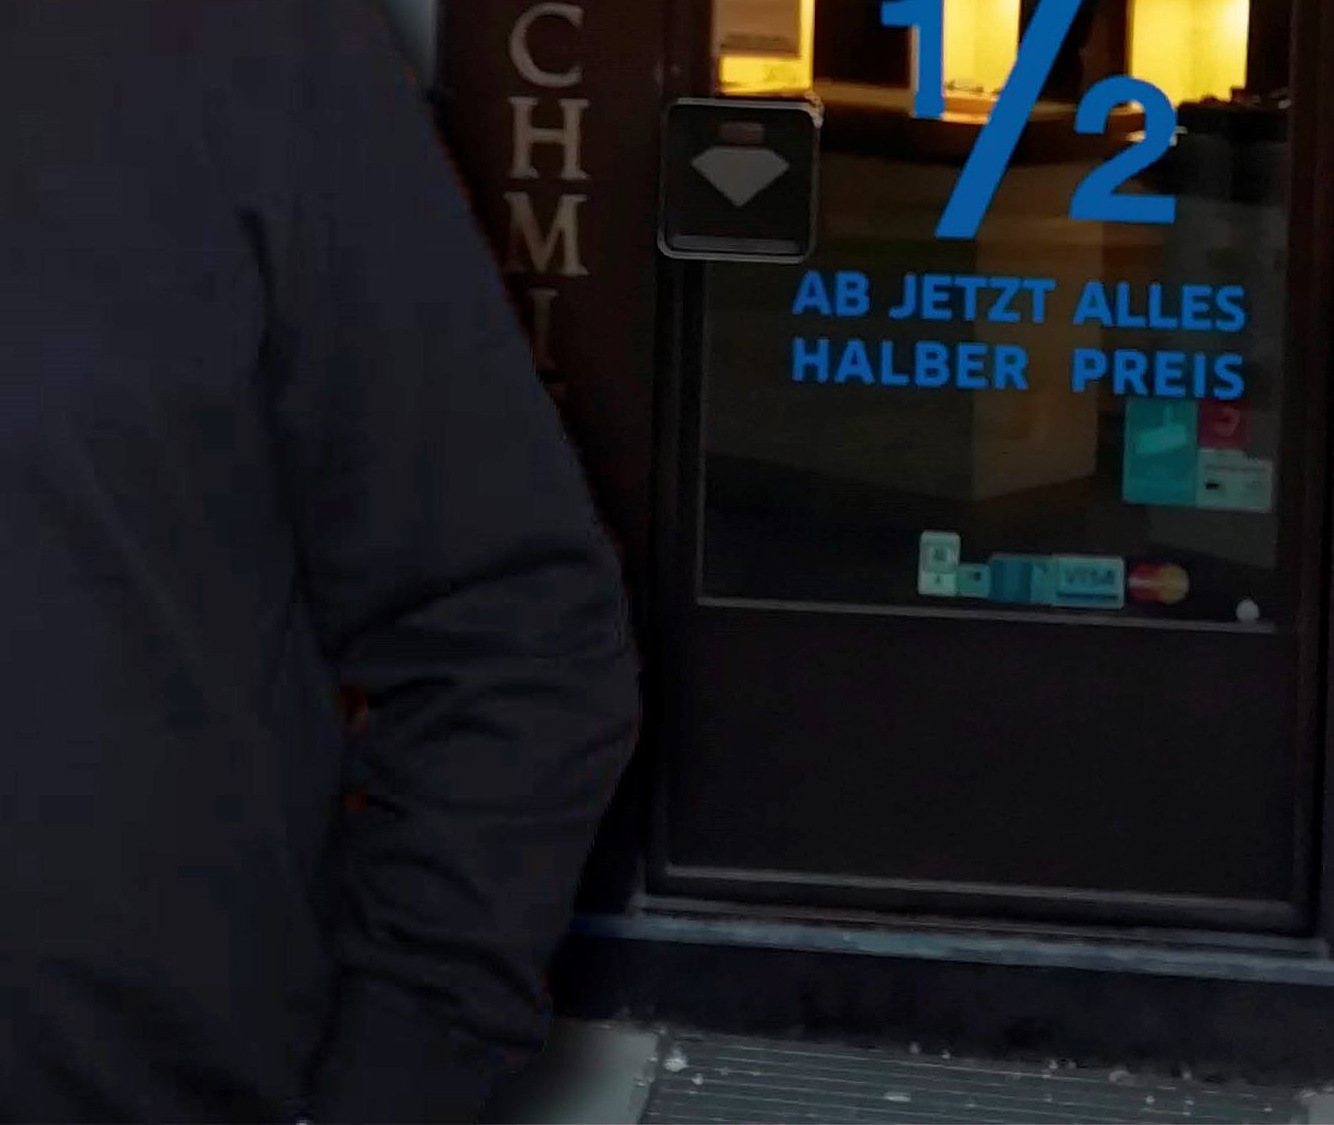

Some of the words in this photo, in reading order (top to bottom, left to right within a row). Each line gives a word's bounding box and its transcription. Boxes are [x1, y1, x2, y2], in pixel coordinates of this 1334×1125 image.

[792, 271, 871, 316] AB
[888, 274, 1056, 325] JETZT
[1073, 282, 1246, 332] ALLES
[791, 338, 1029, 390] HALBER
[1072, 349, 1245, 399] PREIS
